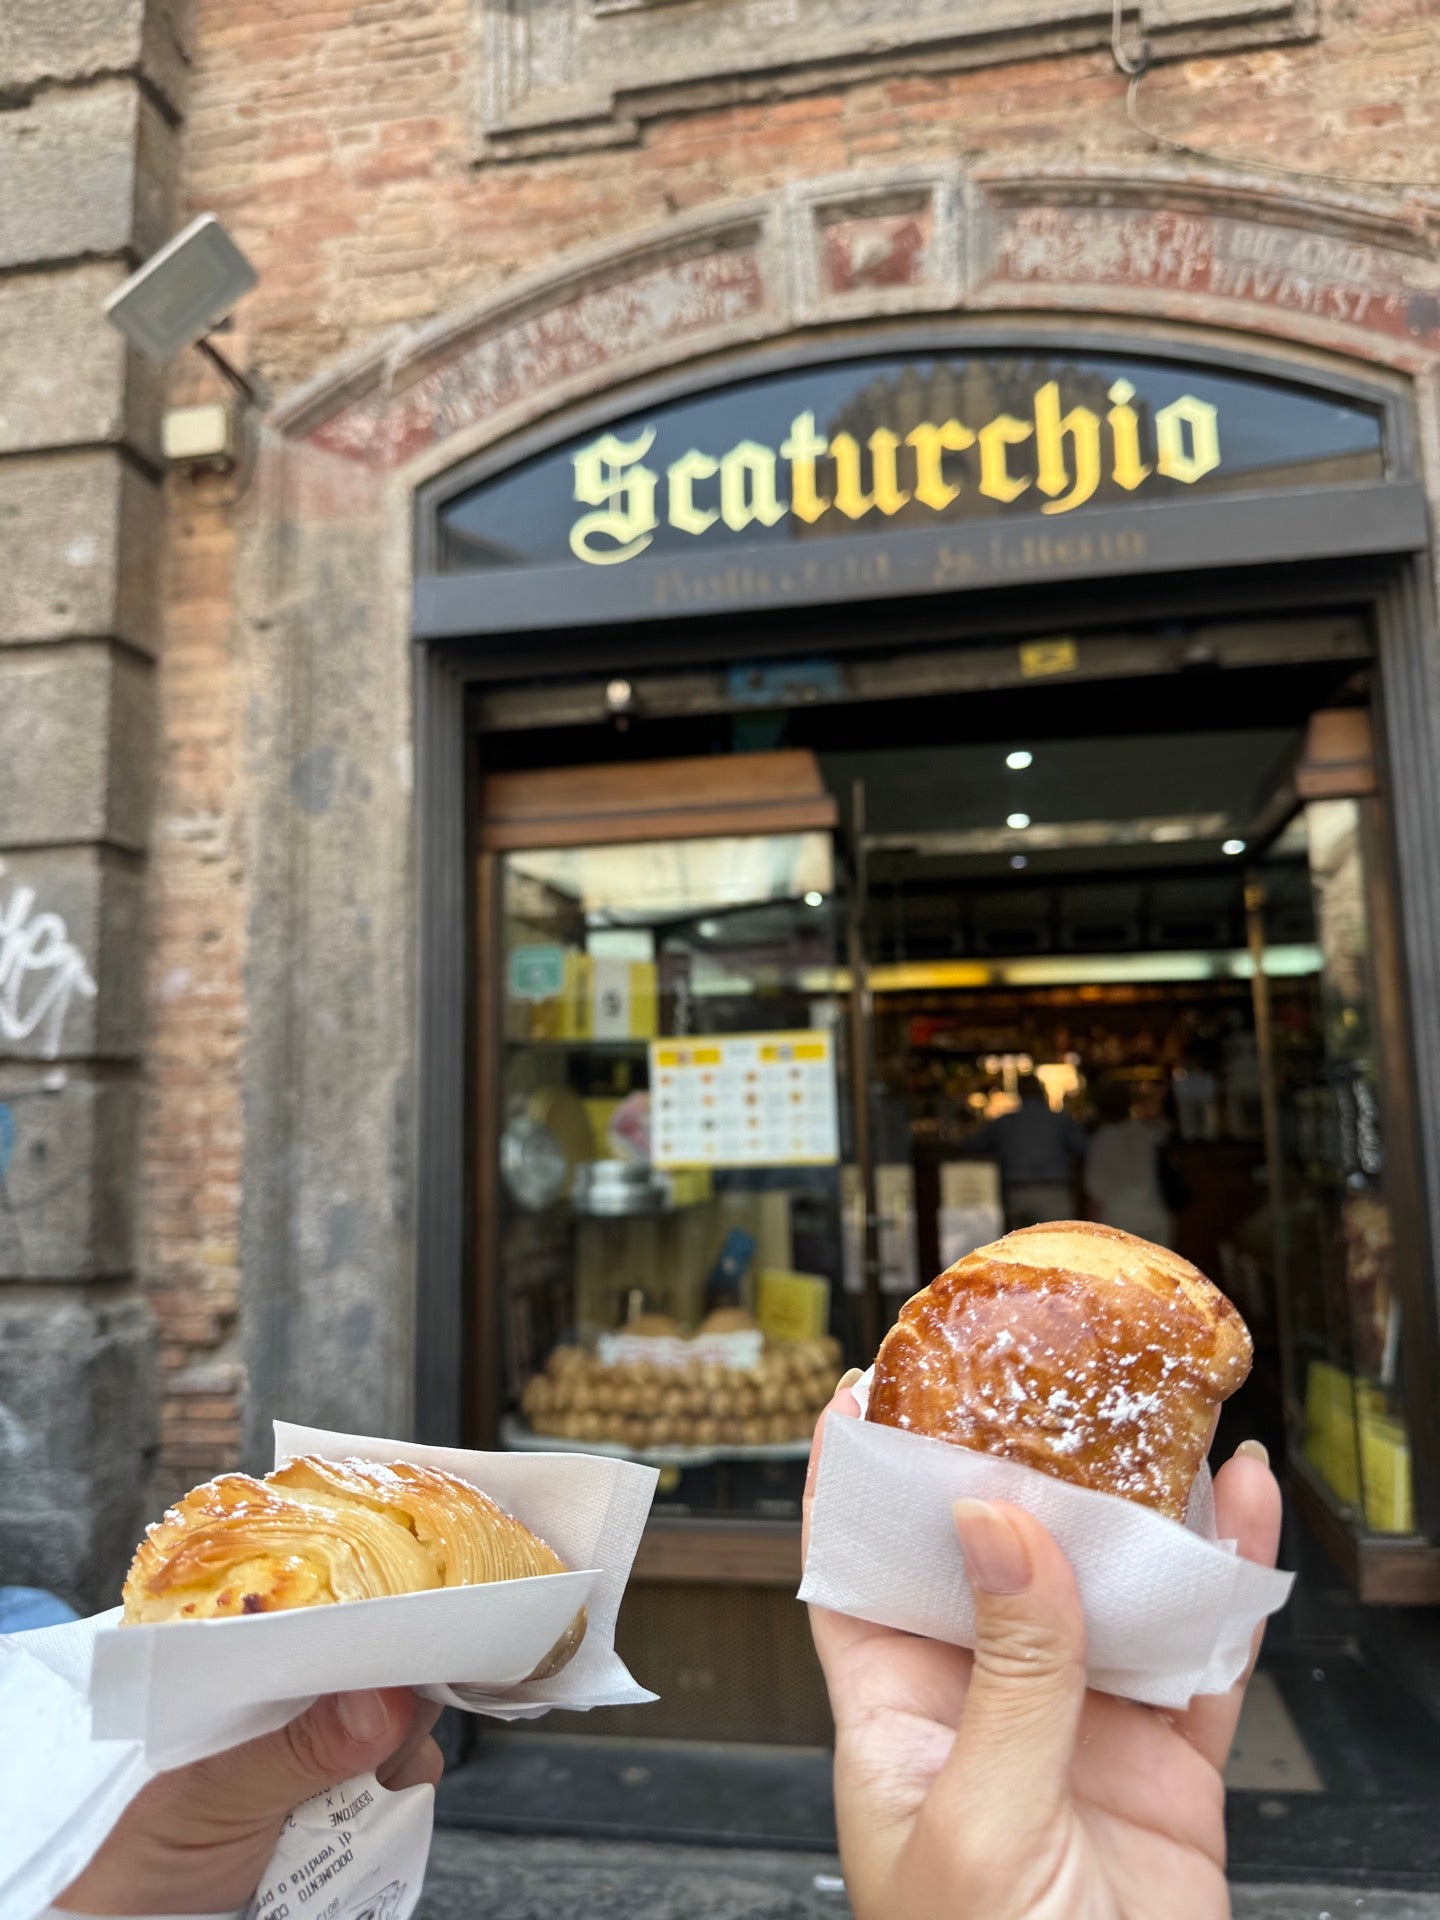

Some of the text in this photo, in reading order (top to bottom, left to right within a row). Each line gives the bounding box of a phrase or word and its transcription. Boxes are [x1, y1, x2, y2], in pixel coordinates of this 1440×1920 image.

[568, 377, 1221, 565] Scaturchio
[338, 1831, 352, 1847] di
[291, 1845, 335, 1884] vendita
[298, 1849, 354, 1902] DOCUMENTO
